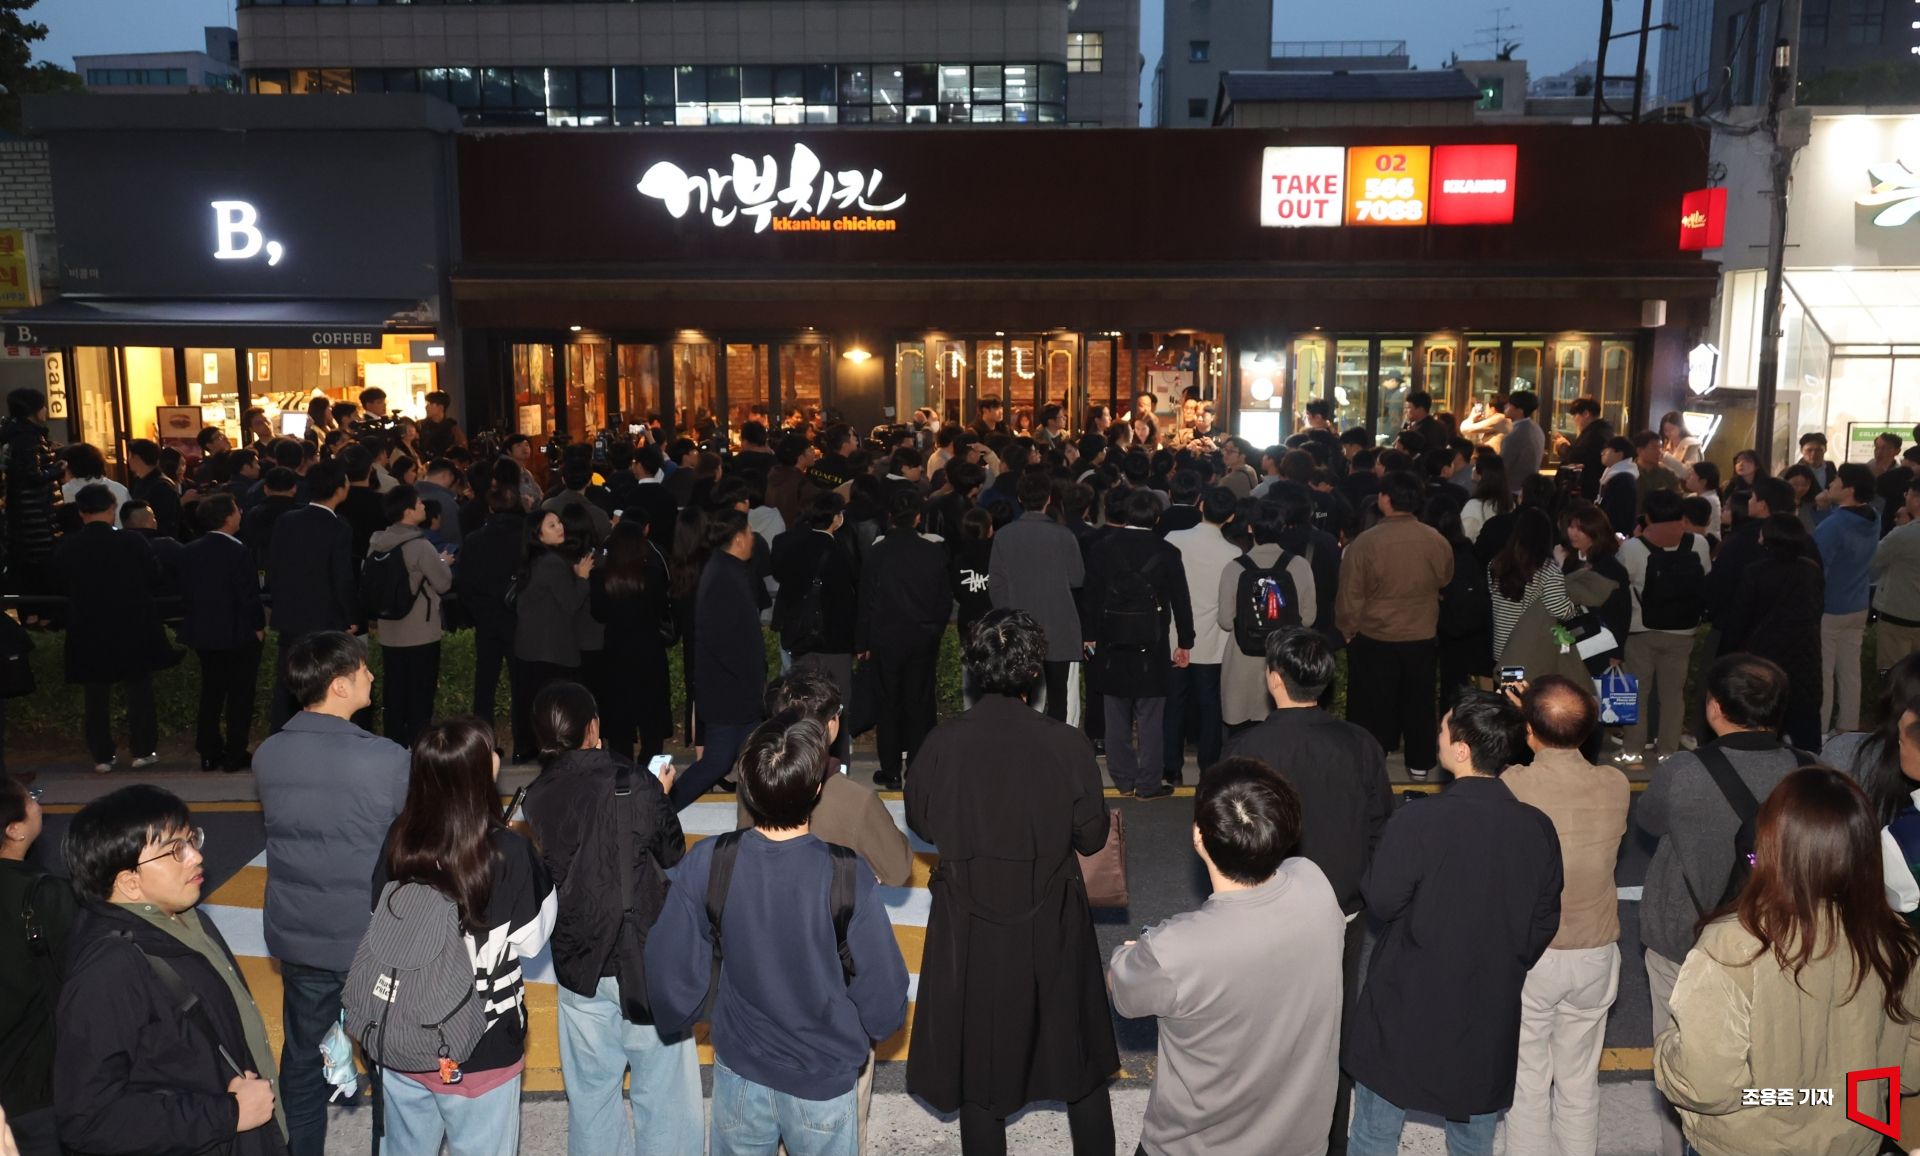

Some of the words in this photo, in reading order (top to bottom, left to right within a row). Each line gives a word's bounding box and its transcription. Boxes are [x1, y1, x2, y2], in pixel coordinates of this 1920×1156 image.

[1375, 154, 1407, 172] 02
[637, 142, 907, 234] 깐부치킨
[1271, 174, 1338, 194] TAKE
[1365, 177, 1415, 199] 566
[1277, 199, 1329, 219] OUT
[1355, 199, 1423, 221] 7088
[210, 200, 283, 267] B,
[773, 216, 831, 231] kkanbu
[832, 215, 896, 231] chicken
[312, 332, 372, 345] COFFEE
[47, 356, 66, 414] cafe
